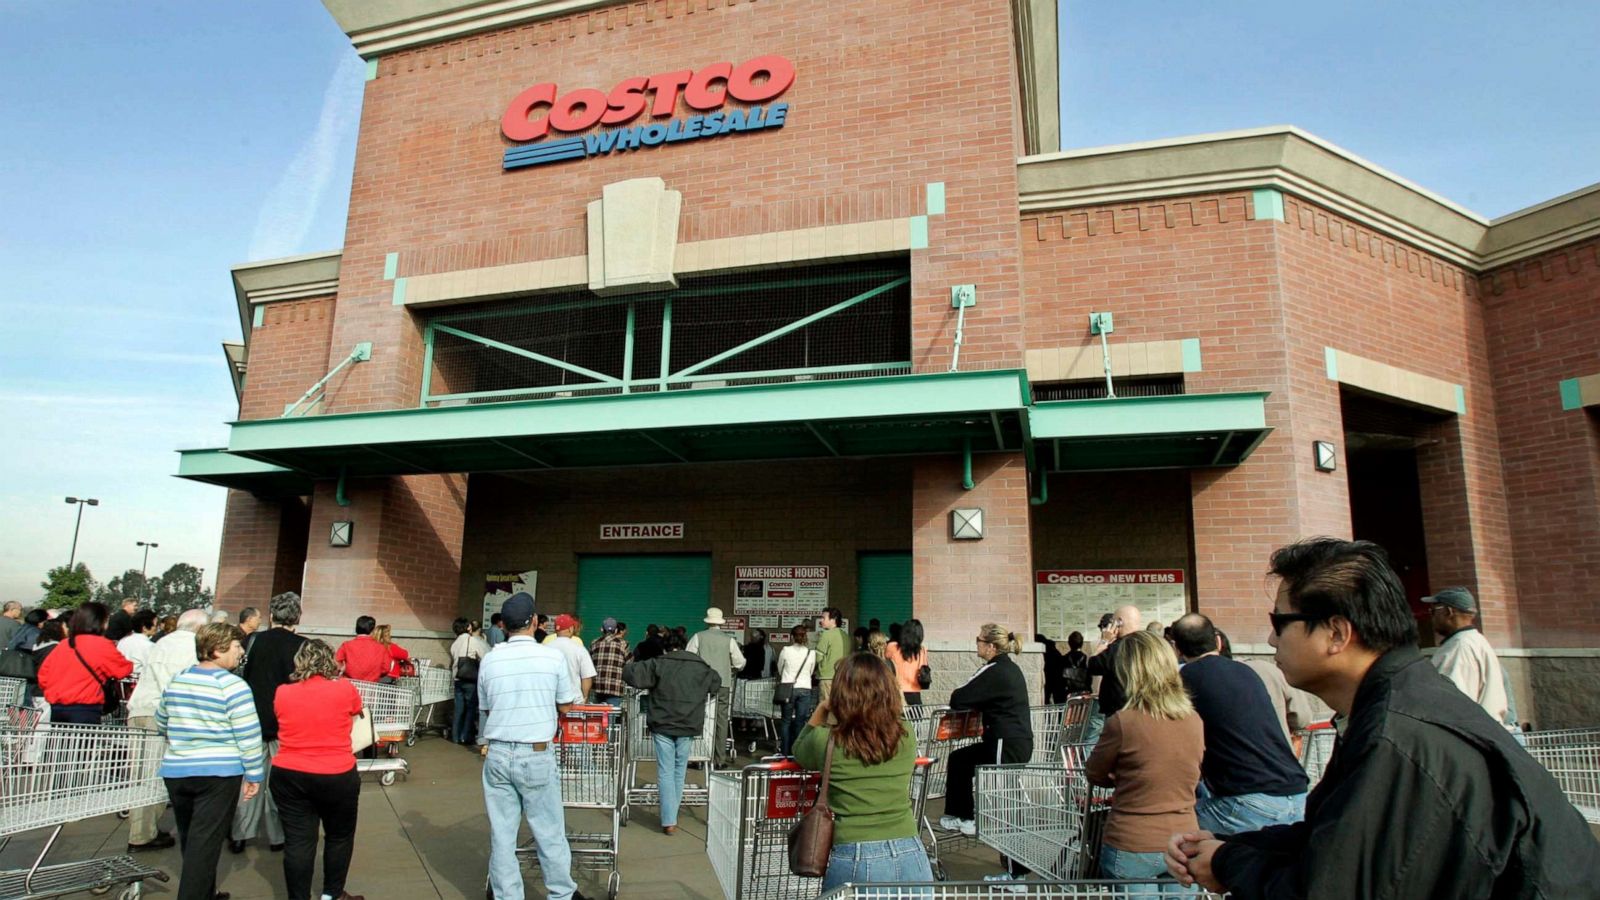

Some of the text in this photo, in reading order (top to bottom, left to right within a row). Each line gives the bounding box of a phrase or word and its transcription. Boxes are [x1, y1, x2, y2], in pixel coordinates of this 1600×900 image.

[501, 55, 796, 142] COSTCO
[583, 102, 789, 157] WHOLESALE
[602, 525, 682, 538] ENTRANCE
[738, 567, 826, 578] WAREHOUSE HOURS
[1109, 574, 1136, 583] NEW
[1138, 573, 1176, 583] ITEMS
